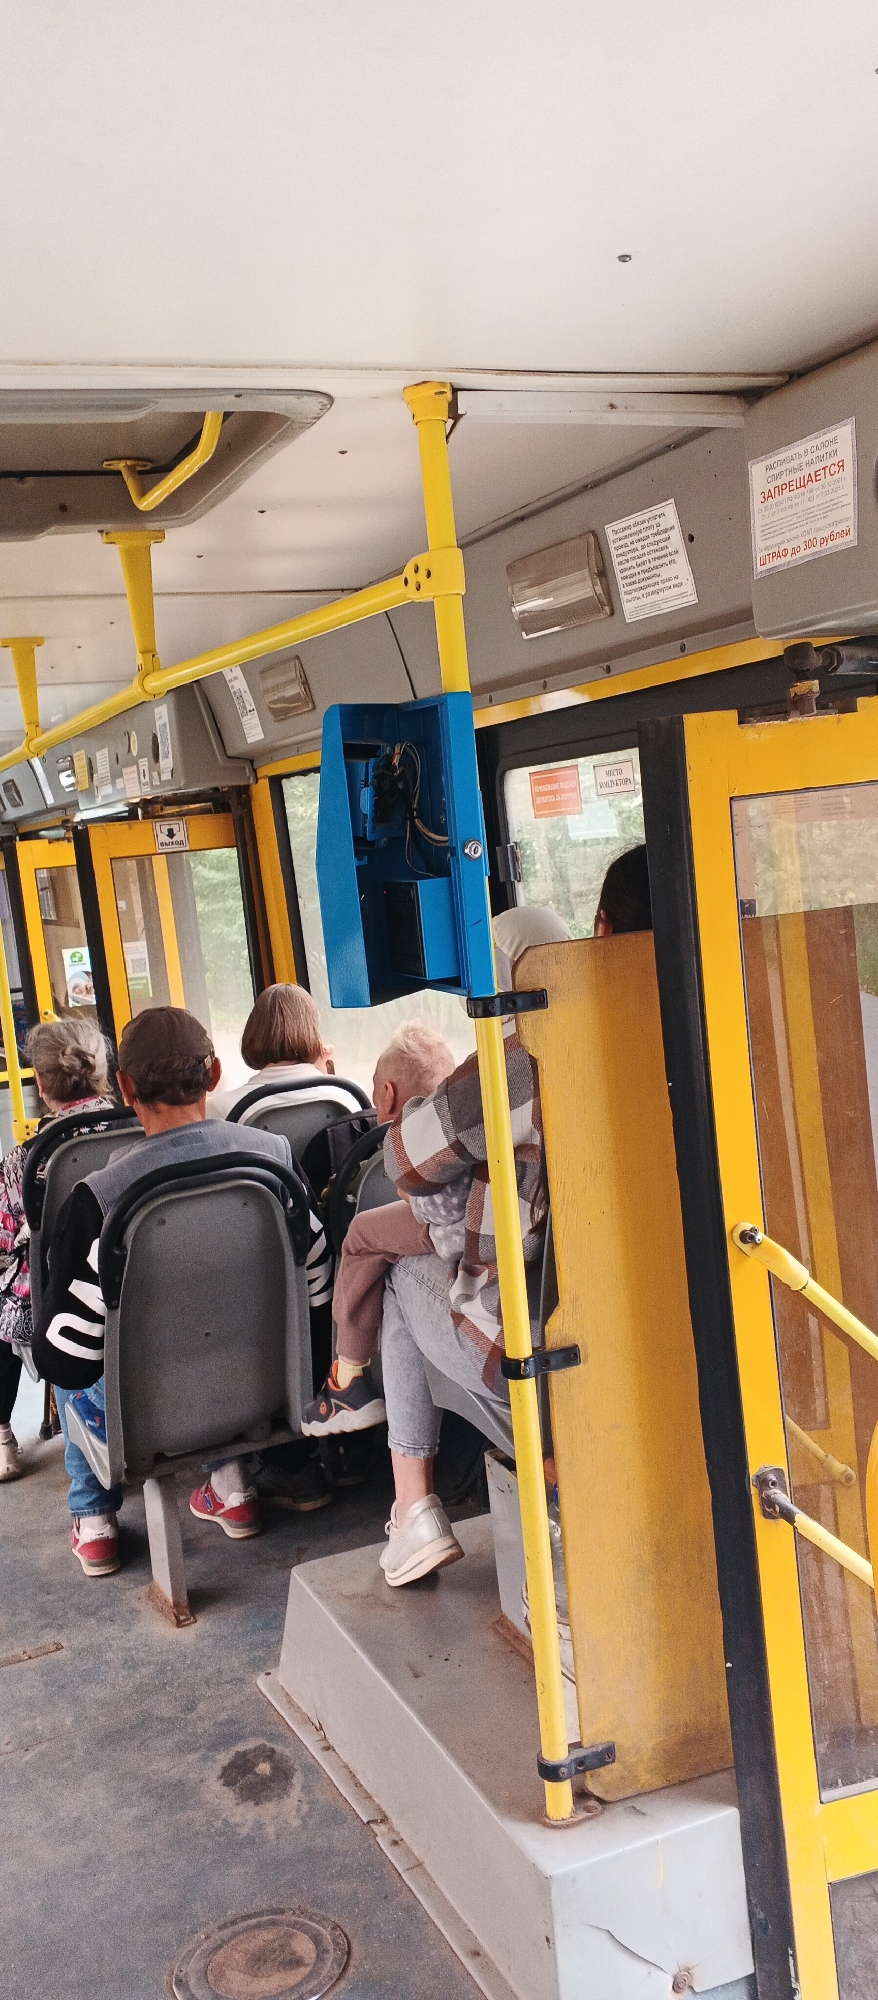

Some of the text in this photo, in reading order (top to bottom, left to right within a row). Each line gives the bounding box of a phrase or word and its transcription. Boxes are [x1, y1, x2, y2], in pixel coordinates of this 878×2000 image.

[766, 436, 838, 472] РАСПИВАТЬ В САЛОНЕ
[767, 448, 837, 484] СПИРТНЫЕ НАПИТКИ
[761, 460, 844, 503] ЗАПРЕЩАЕТСЯ
[612, 525, 632, 536] Пассажир
[760, 526, 850, 566] ШТРАФ до 300 рублей
[599, 777, 632, 789] КОНДУКТОРА
[605, 768, 623, 777] МЕСТО
